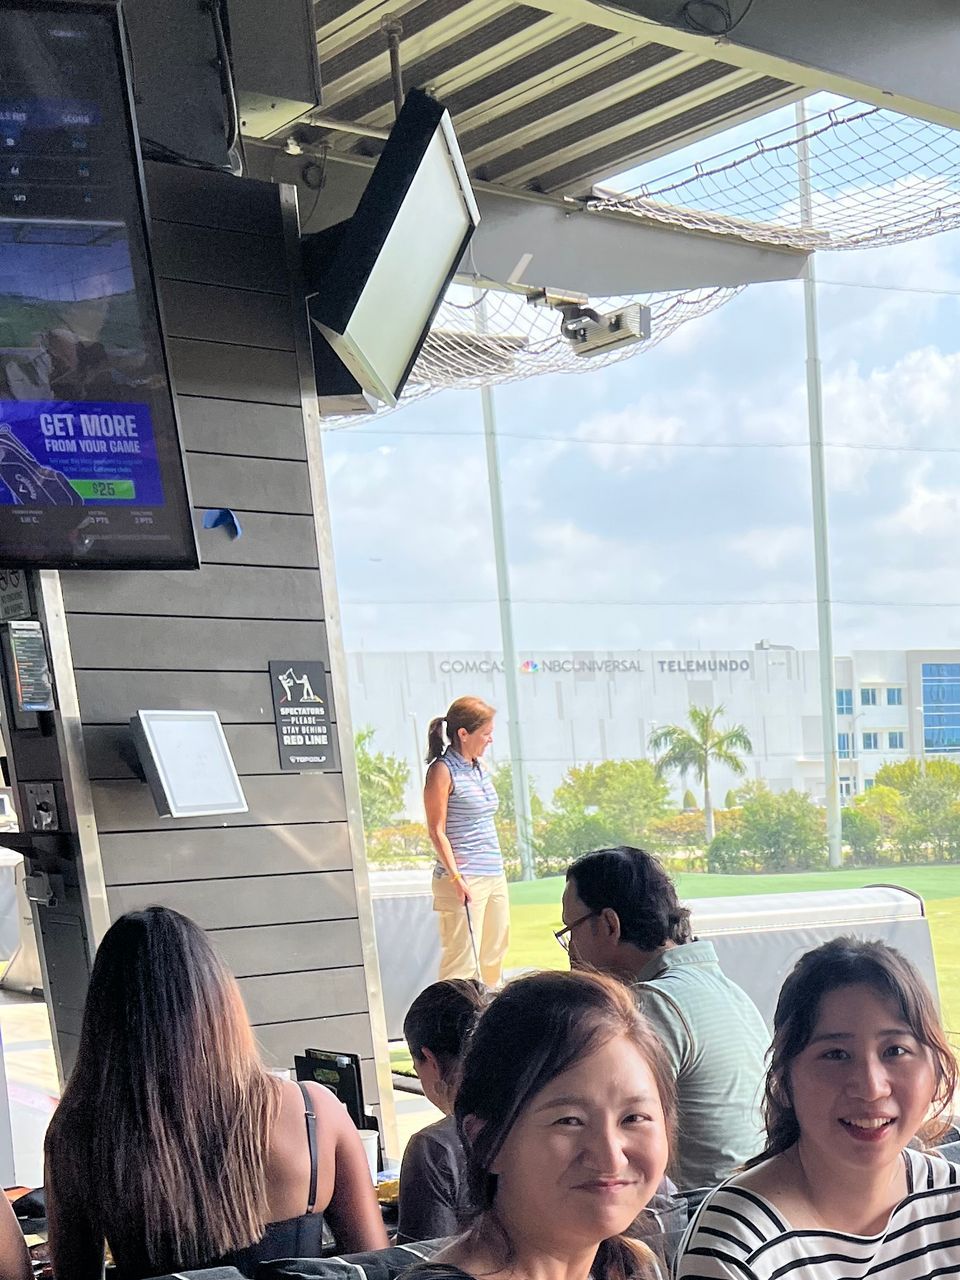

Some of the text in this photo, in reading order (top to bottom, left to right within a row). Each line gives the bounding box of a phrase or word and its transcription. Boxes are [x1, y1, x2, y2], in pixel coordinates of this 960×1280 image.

[39, 413, 139, 438] GET MORE
[44, 438, 141, 454] FROM YOUR GAME
[92, 482, 116, 497] $25
[440, 659, 750, 674] COMCA NBCUNIVERSAL TELEMUNDO
[280, 707, 325, 715] SPECTATORS
[291, 716, 316, 725] PLEASE
[282, 725, 327, 734] STAY BEHIND
[283, 735, 328, 745] RED LINE
